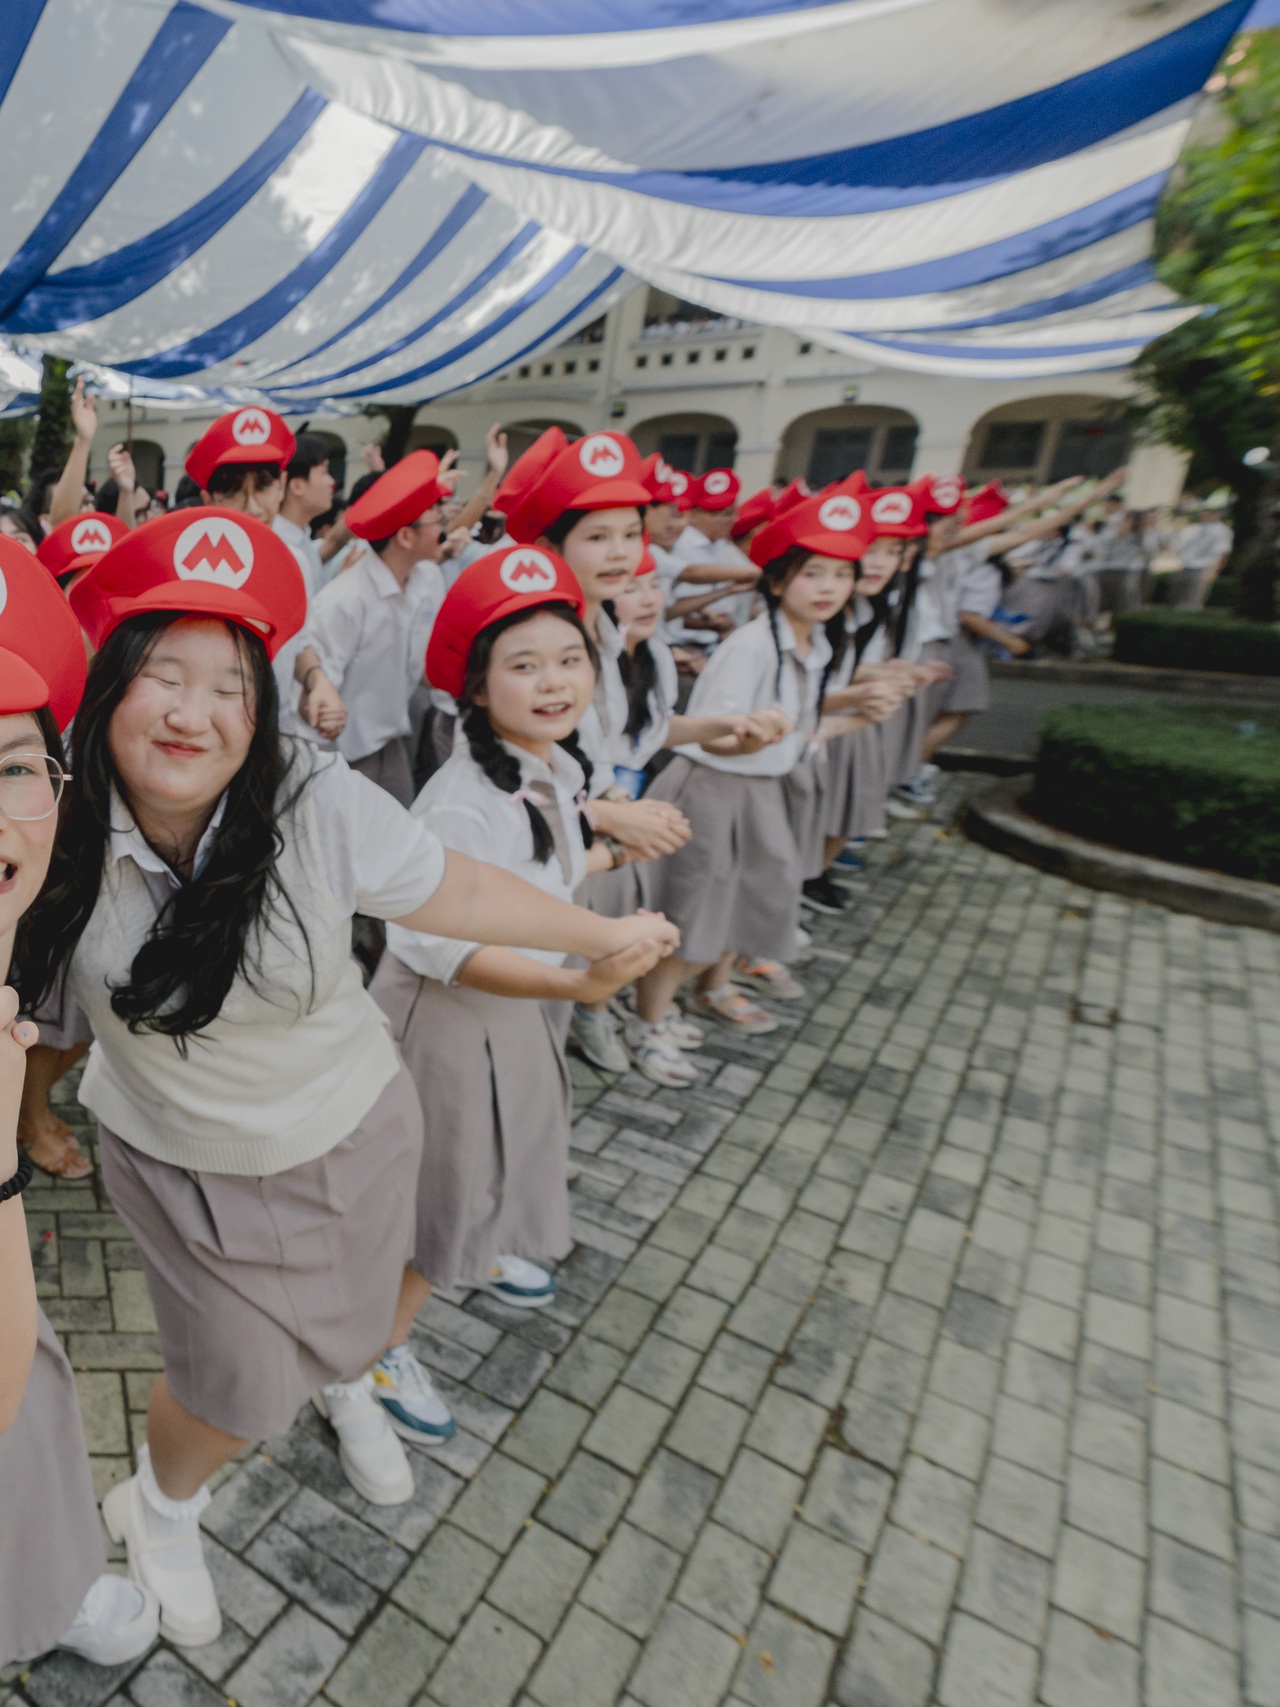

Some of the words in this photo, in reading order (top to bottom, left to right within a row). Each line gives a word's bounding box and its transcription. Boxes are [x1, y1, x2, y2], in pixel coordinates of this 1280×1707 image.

[239, 417, 265, 434] M
[589, 446, 615, 465] M
[77, 528, 106, 545] M
[181, 532, 245, 575] M
[509, 558, 549, 581] M
